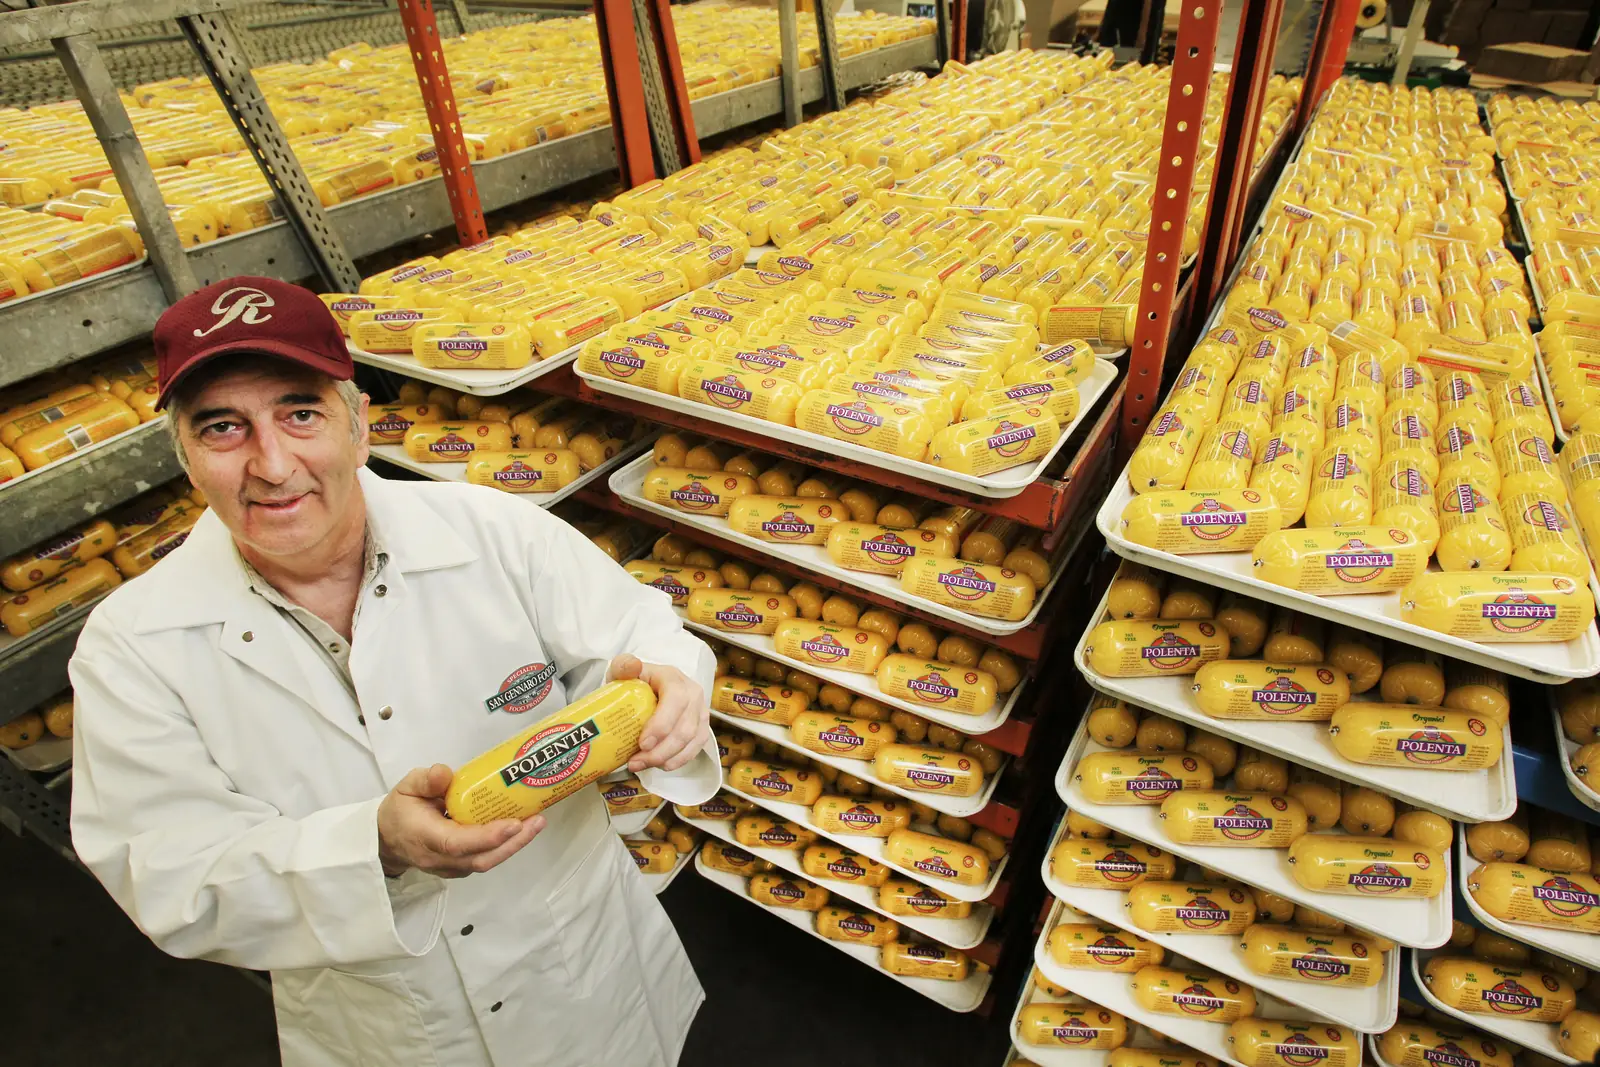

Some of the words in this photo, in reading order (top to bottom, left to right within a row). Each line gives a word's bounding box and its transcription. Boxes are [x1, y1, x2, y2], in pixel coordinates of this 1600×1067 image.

[779, 258, 813, 270] POLENTA
[193, 287, 275, 337] R
[332, 302, 373, 311] POLENTA
[376, 313, 421, 321] POLENTA
[692, 308, 732, 321] POLENTA
[1250, 307, 1286, 328] POLENTA
[810, 316, 853, 328] POLENTA
[440, 341, 485, 350] POLENTA
[602, 353, 643, 367] POLENTA
[738, 353, 785, 367] POLENTA
[704, 382, 750, 399] POLENTA
[855, 383, 907, 399] POLENTA
[1008, 385, 1052, 398] POLENTA
[829, 406, 879, 425] POLENTA
[371, 422, 411, 431] POLENTA
[990, 429, 1034, 447] POLENTA
[432, 443, 472, 451] POLENTA
[496, 472, 540, 480] POLENTA
[673, 492, 717, 503] POLENTA
[1186, 514, 1243, 524] POLENTA
[765, 523, 812, 533] POLENTA
[1334, 530, 1366, 538] Organic!
[864, 542, 912, 555] POLENTA
[1330, 555, 1389, 566] POLENTA
[941, 575, 992, 591] POLENTA
[1492, 576, 1527, 585] Organic!
[1487, 605, 1552, 617] POLENTA
[718, 613, 760, 622] POLENTA
[804, 642, 847, 655] POLENTA
[1145, 647, 1196, 657] POLENTA
[507, 665, 538, 684] SPECIALTY
[1265, 667, 1296, 675] Organic!
[488, 695, 505, 710] SAN
[504, 678, 538, 702] GENNARO
[537, 663, 556, 683] FOODS
[910, 681, 956, 696] POLENTA
[735, 695, 773, 708] POLENTA
[1255, 692, 1312, 703] POLENTA
[1412, 714, 1445, 723] Organic!
[522, 739, 535, 752] San
[534, 726, 566, 742] Gennaro
[821, 733, 861, 744] POLENTA
[507, 725, 594, 782] POLENTA
[1401, 740, 1461, 755] POLENTA
[526, 766, 572, 786] TRADITIONAL
[568, 745, 588, 771] ITALIAN
[910, 771, 951, 783] POLENTA
[755, 779, 790, 791] POLENTA
[1130, 780, 1179, 790] POLENTA
[604, 789, 637, 798] POLENTA
[841, 814, 879, 823] POLENTA
[1217, 819, 1269, 829] POLENTA
[761, 834, 794, 842] POLENTA
[1364, 849, 1394, 857] Organic!
[829, 864, 863, 875] POLENTA
[917, 862, 955, 876] POLENTA
[1098, 862, 1143, 872] POLENTA
[1353, 875, 1407, 887] POLENTA
[772, 887, 802, 897] POLENTA
[1537, 888, 1596, 905] POLENTA
[909, 898, 944, 906] POLENTA
[1179, 910, 1227, 919] POLENTA
[841, 921, 872, 931] POLENTA
[1295, 960, 1347, 973] POLENTA
[1176, 995, 1222, 1008] POLENTA
[1486, 992, 1539, 1007] POLENTA
[1056, 1029, 1095, 1037] POLENTA
[1278, 1046, 1325, 1057] POLENTA
[1427, 1052, 1476, 1067] POLENTA
